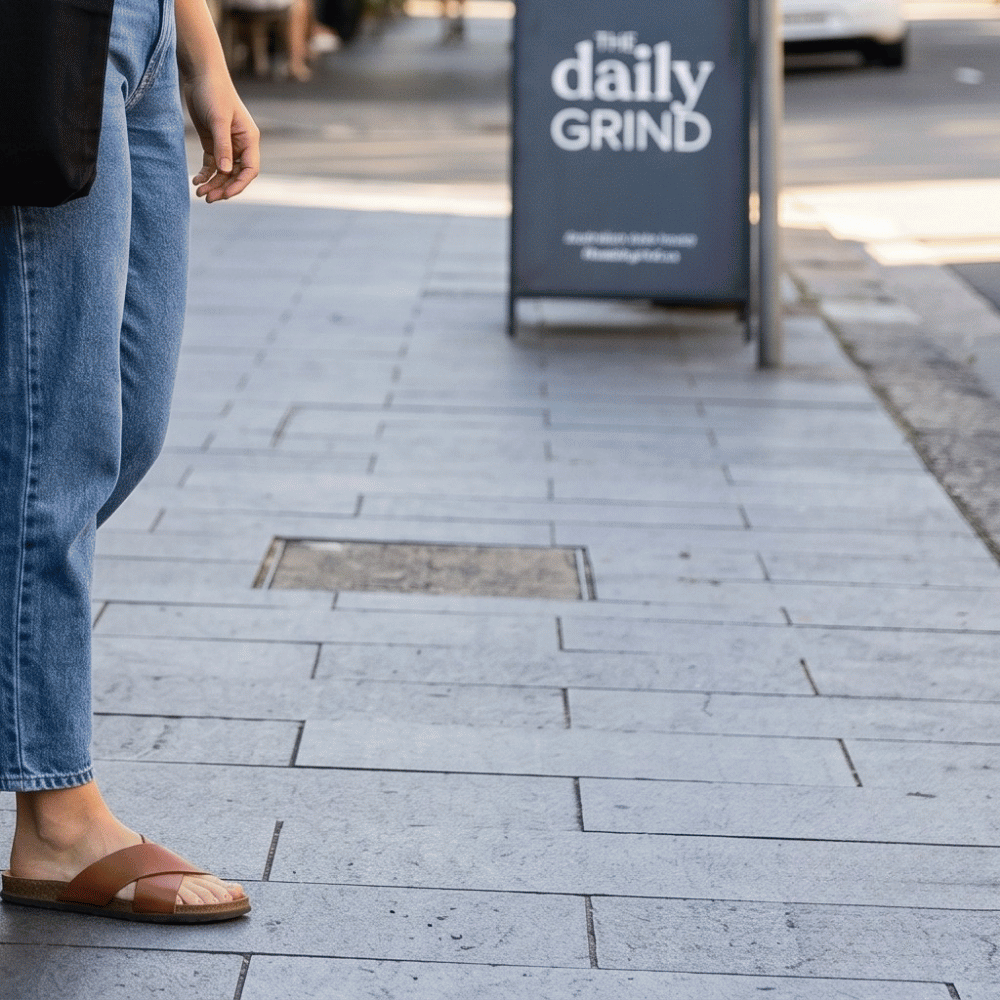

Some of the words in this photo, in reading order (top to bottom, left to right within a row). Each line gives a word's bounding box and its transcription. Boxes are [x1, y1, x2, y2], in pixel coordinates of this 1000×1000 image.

[593, 30, 638, 54] THE
[551, 39, 715, 116] daily
[550, 107, 713, 153] GRIND
